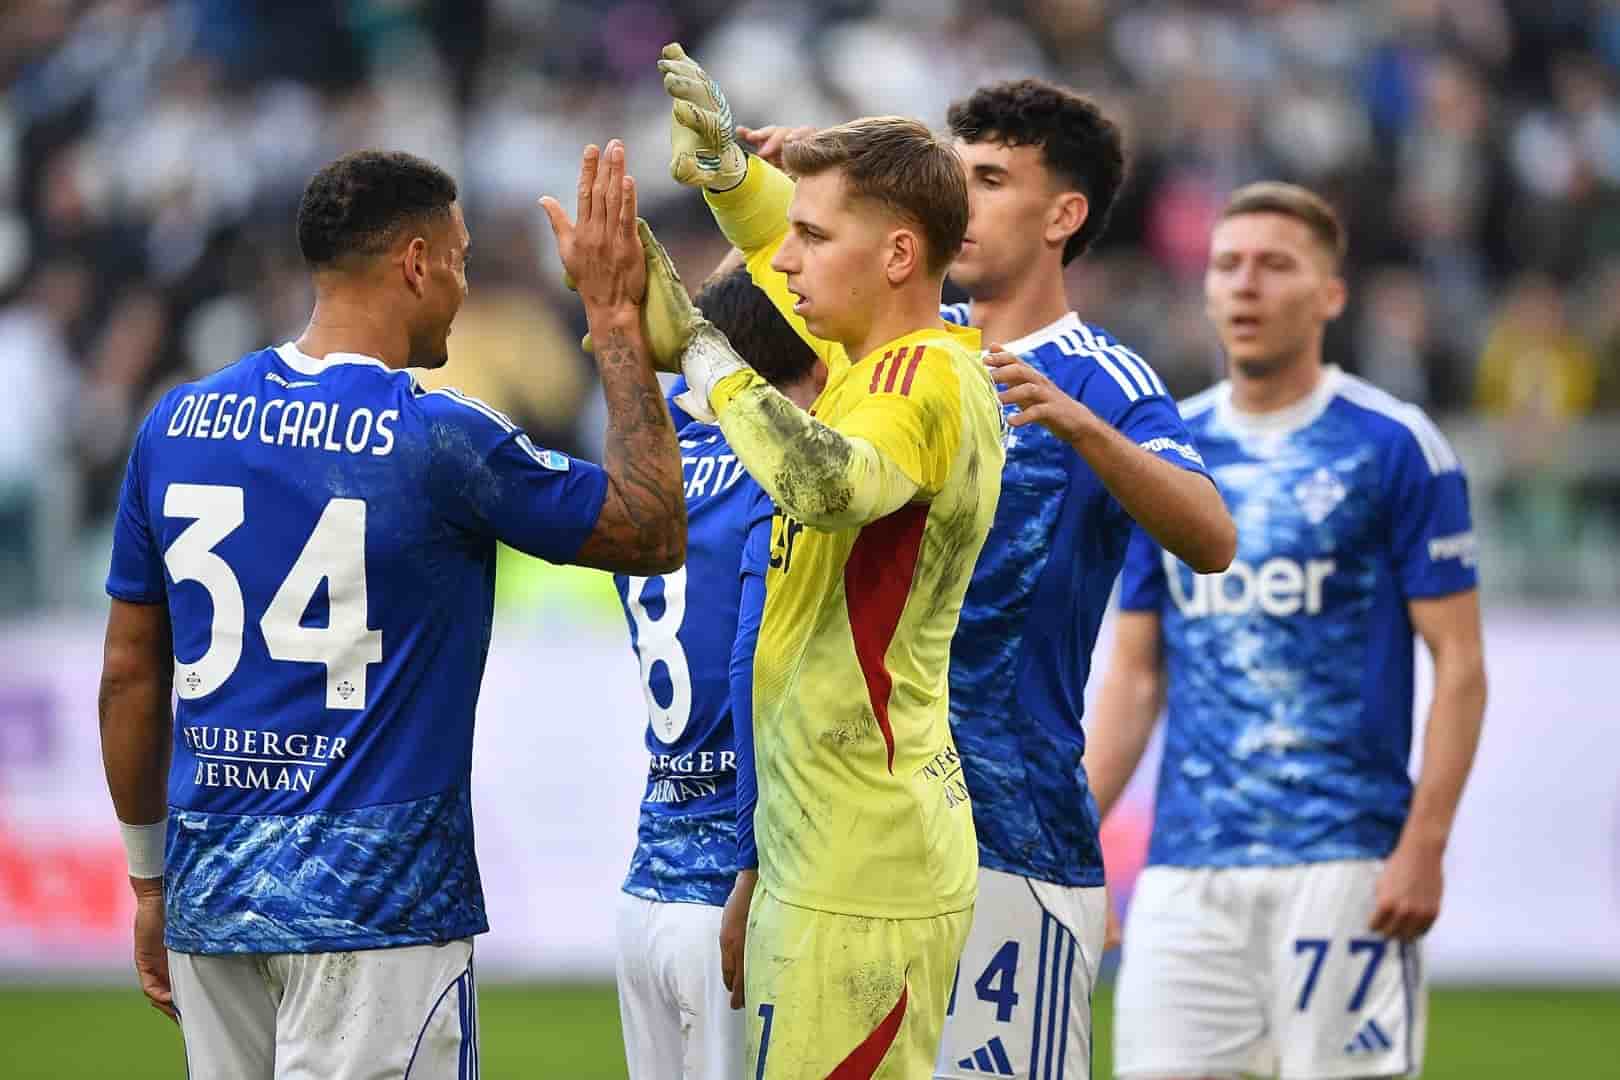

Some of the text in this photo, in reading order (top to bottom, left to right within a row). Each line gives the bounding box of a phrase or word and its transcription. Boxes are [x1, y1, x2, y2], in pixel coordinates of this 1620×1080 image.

[167, 393, 398, 456] DIEGO CARLOS
[163, 483, 383, 711] 34
[1294, 939, 1387, 1012] 77
